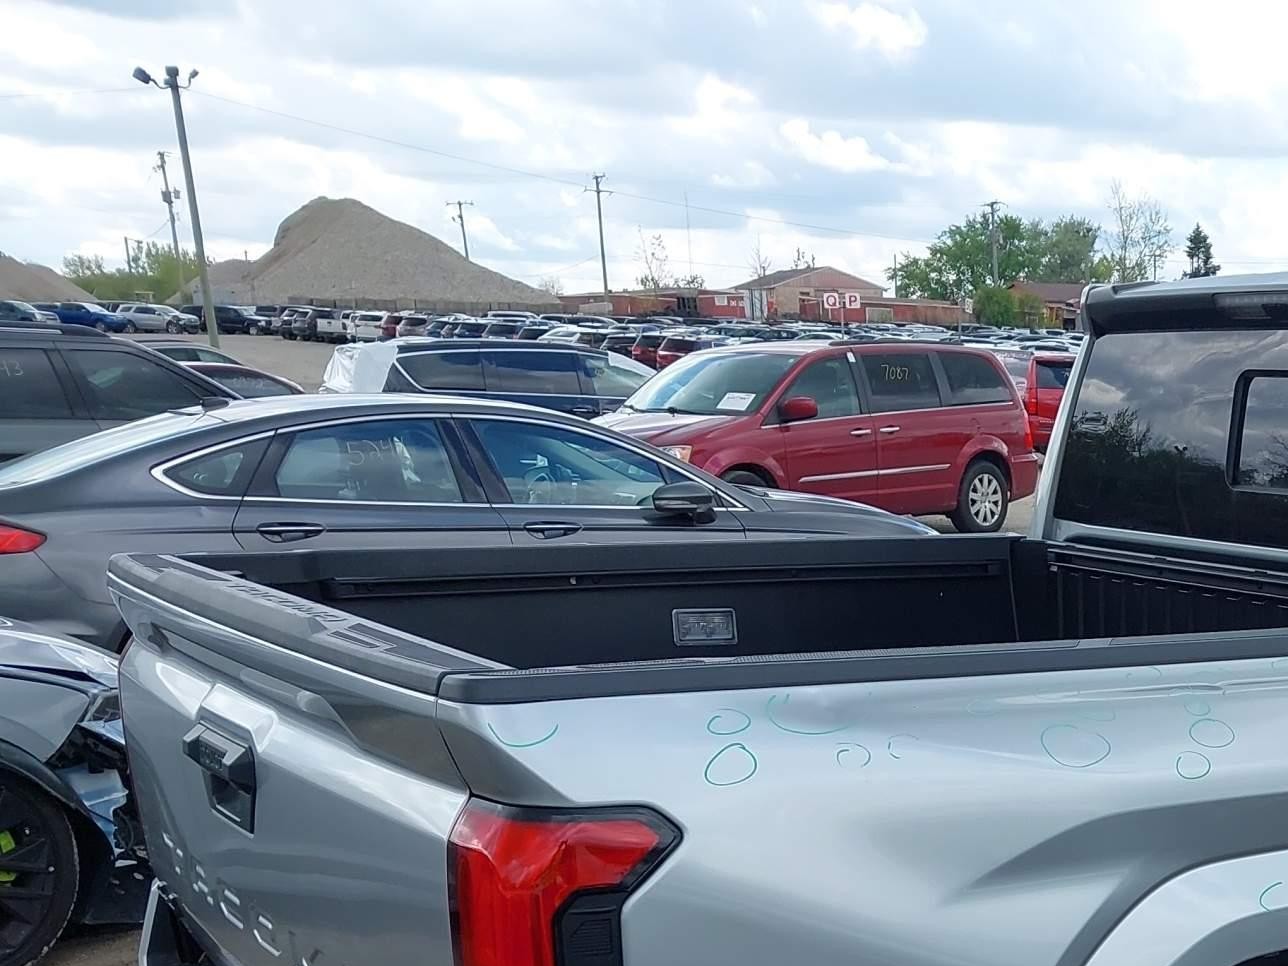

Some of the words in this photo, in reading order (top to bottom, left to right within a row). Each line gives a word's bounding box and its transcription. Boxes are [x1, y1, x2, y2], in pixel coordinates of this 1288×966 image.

[826, 294, 838, 307] Q
[848, 294, 857, 307] P
[880, 364, 909, 381] 7087
